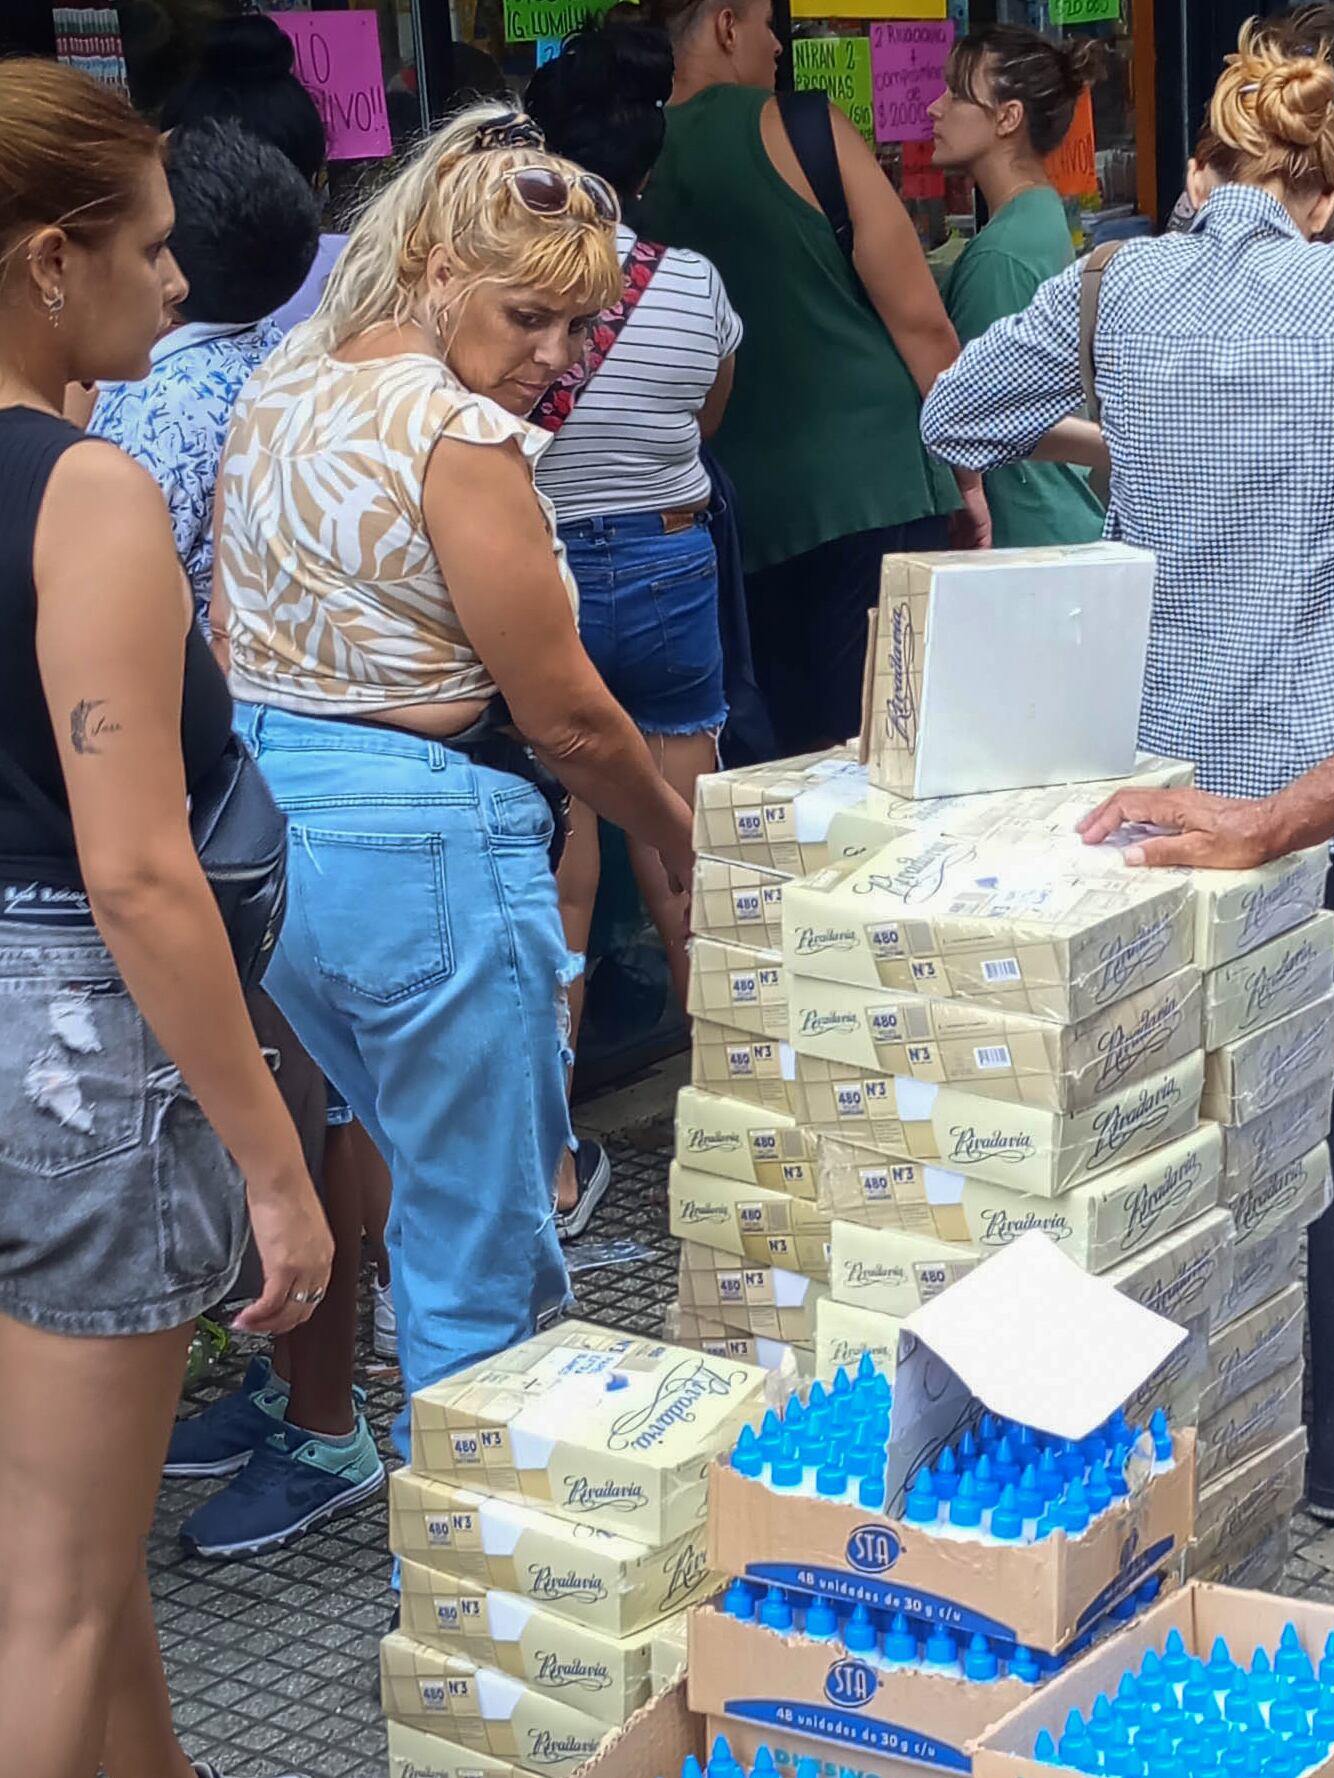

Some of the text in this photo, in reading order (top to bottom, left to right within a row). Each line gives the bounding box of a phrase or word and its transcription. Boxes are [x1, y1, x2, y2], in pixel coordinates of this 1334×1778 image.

[846, 40, 856, 70] 2
[737, 816, 761, 830] 480
[736, 897, 759, 910] 480
[872, 931, 900, 946] 480
[732, 978, 755, 992] 480
[872, 1013, 898, 1028] 480
[730, 1053, 750, 1065] 480
[837, 1090, 862, 1105] 480
[753, 1135, 776, 1149] 480
[948, 1125, 1037, 1164] Rivadavia
[863, 1176, 889, 1190] 480
[740, 1208, 762, 1222] 480
[979, 1207, 1074, 1247] Rivadavia
[920, 1270, 946, 1284] 480
[719, 1281, 741, 1293] 480
[454, 1438, 478, 1455] 480
[562, 1474, 649, 1513] Rivadavia
[428, 1522, 450, 1538] 480
[854, 1532, 889, 1566] STA
[527, 1562, 608, 1605] Rivadavia
[818, 1578, 880, 1603] unidades
[903, 1596, 923, 1612] 30
[437, 1606, 458, 1622] 480
[533, 1650, 614, 1691] Rivadavia
[834, 1665, 868, 1700] STA
[422, 1686, 444, 1702] 480
[775, 1706, 794, 1722] 48
[797, 1712, 858, 1739] unidades
[880, 1731, 899, 1747] 30
